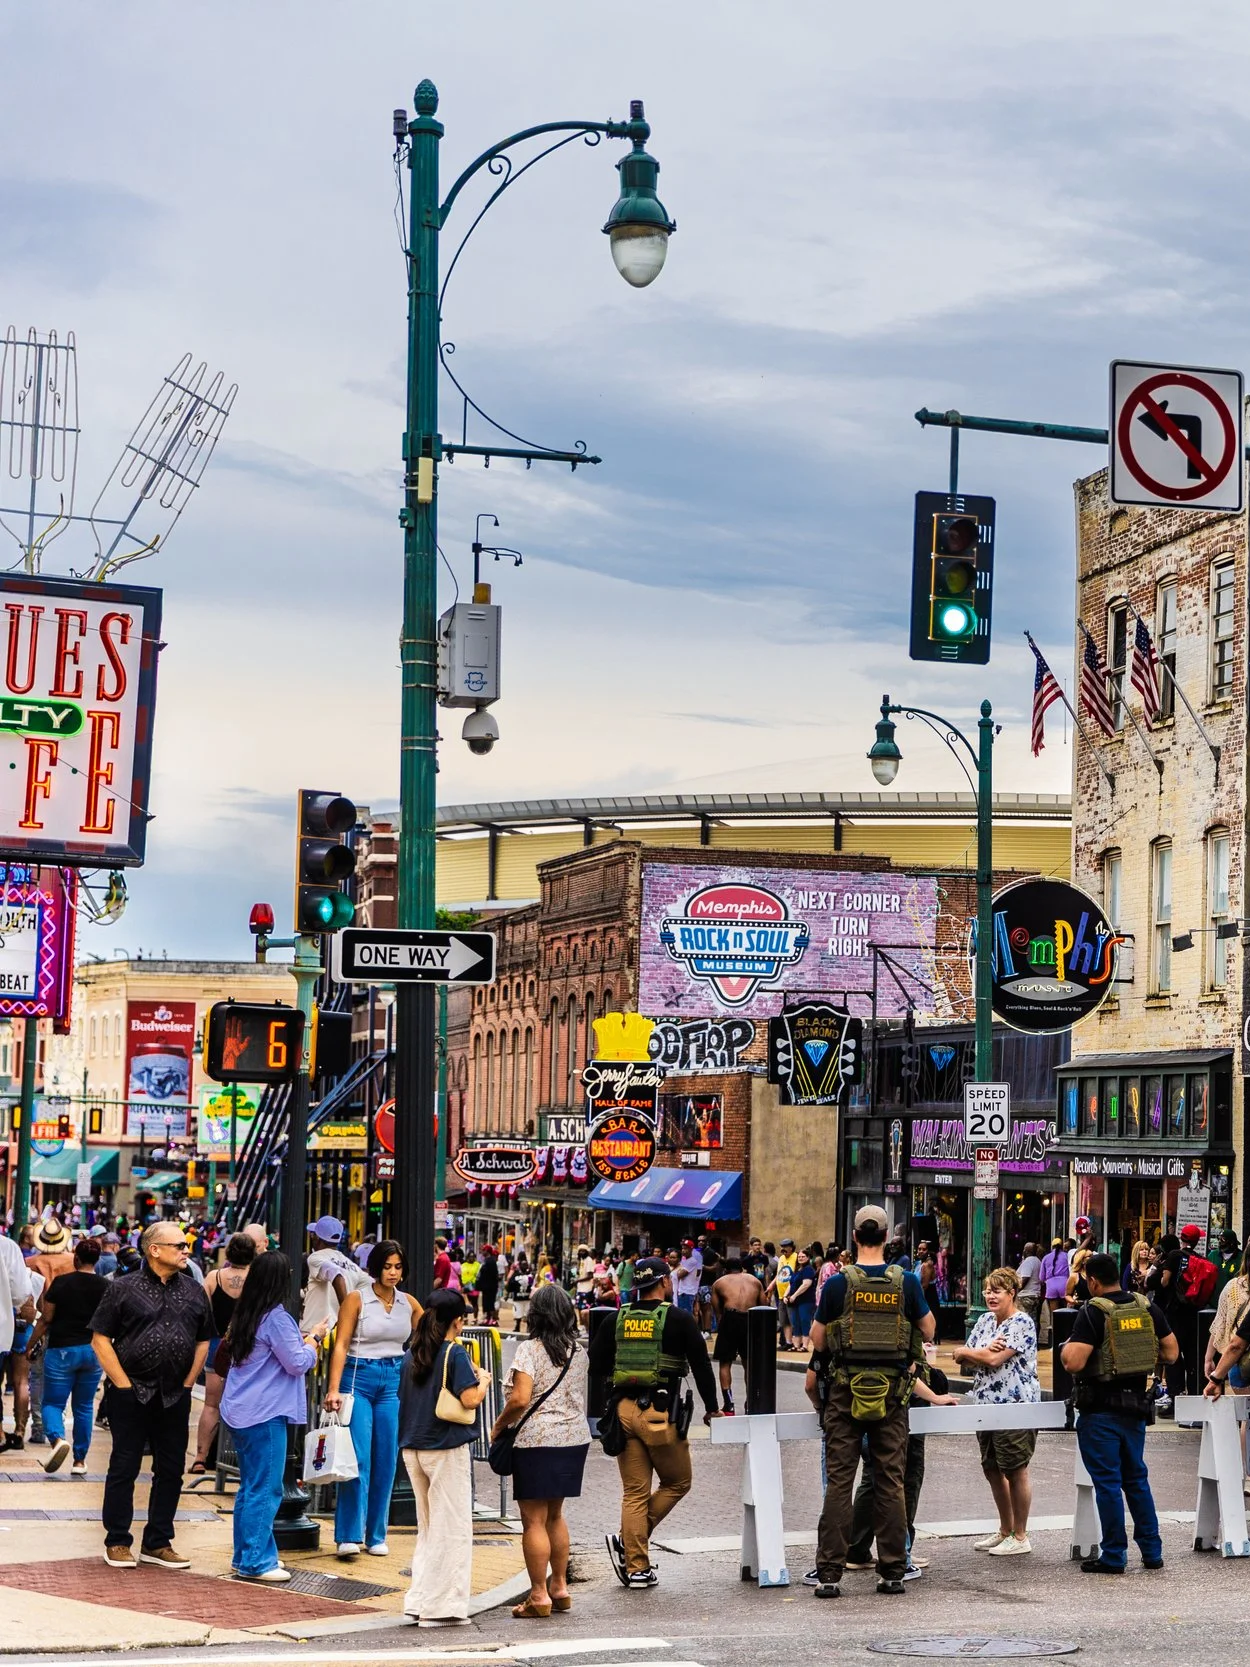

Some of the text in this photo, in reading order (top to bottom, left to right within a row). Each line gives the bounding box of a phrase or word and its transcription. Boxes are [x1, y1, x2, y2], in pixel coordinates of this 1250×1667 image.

[697, 901, 777, 918] Memphis
[799, 891, 901, 913] NEXT CORNER
[832, 917, 869, 936] TURN
[680, 928, 789, 953] ROCK n SOUL
[828, 938, 872, 957] RIGHT
[359, 945, 450, 967] ONE WAY
[131, 1019, 193, 1033] Budweiser
[796, 1018, 837, 1027] BLACK
[794, 1027, 840, 1039] DIAMOND
[268, 1021, 288, 1068] 6
[968, 1090, 1006, 1099] SPEED
[973, 1102, 1001, 1111] LIMIT
[606, 1117, 641, 1134] BAR
[969, 1114, 1005, 1136] 20
[591, 1140, 652, 1157] RESTAURANT
[997, 1119, 1046, 1161] ANTS
[476, 1152, 531, 1170] Schwab
[980, 1150, 994, 1160] NO
[595, 1160, 612, 1175] 159
[1074, 1156, 1185, 1176] Records Souvenirs Musical Gifts
[934, 1174, 952, 1184] ENTER
[856, 1292, 898, 1305] POLICE
[624, 1319, 654, 1331] POLICE
[1120, 1317, 1142, 1330] HSI
